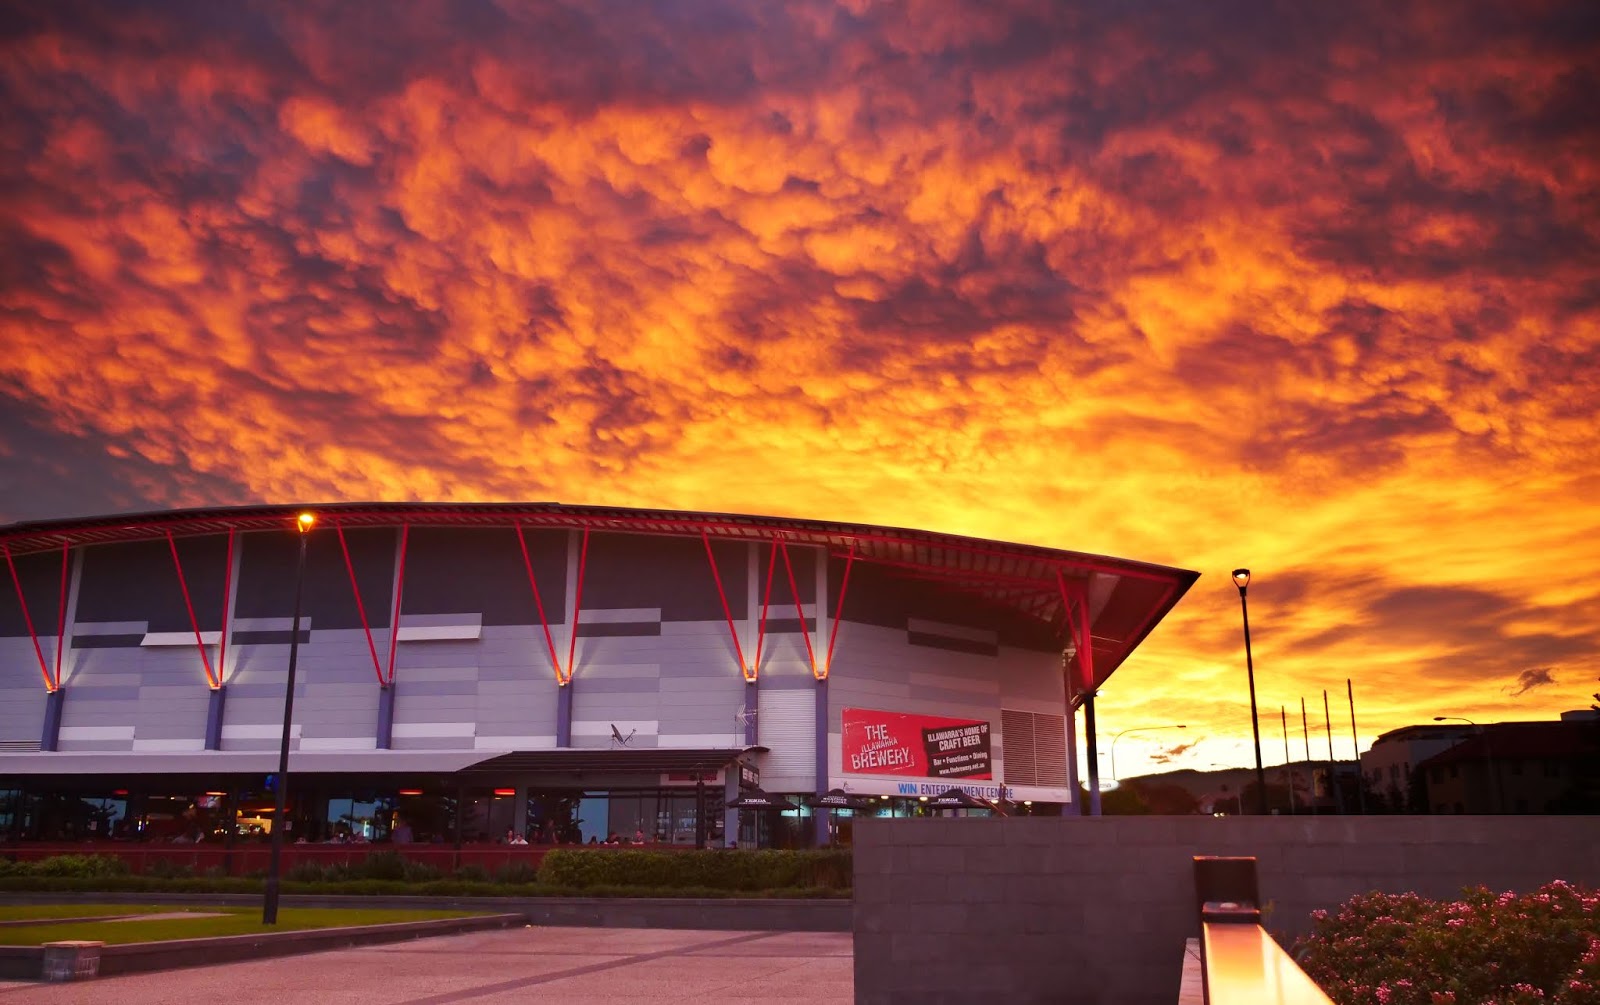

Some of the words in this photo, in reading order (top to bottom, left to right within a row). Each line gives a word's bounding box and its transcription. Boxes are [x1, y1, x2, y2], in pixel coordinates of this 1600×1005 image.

[864, 724, 889, 741] THE
[927, 728, 964, 743] ILLAWARRA'S
[964, 725, 981, 736] HOME
[980, 724, 988, 733] OF
[861, 737, 898, 753] ILLAWARRA
[939, 737, 961, 752] CRAFT
[962, 734, 981, 748] BEER
[851, 747, 909, 770] BREWERY
[933, 758, 942, 766] Bar
[946, 754, 970, 764] Functions
[972, 751, 988, 760] Dining
[898, 783, 917, 795] WIN
[986, 786, 1013, 799] CENRE
